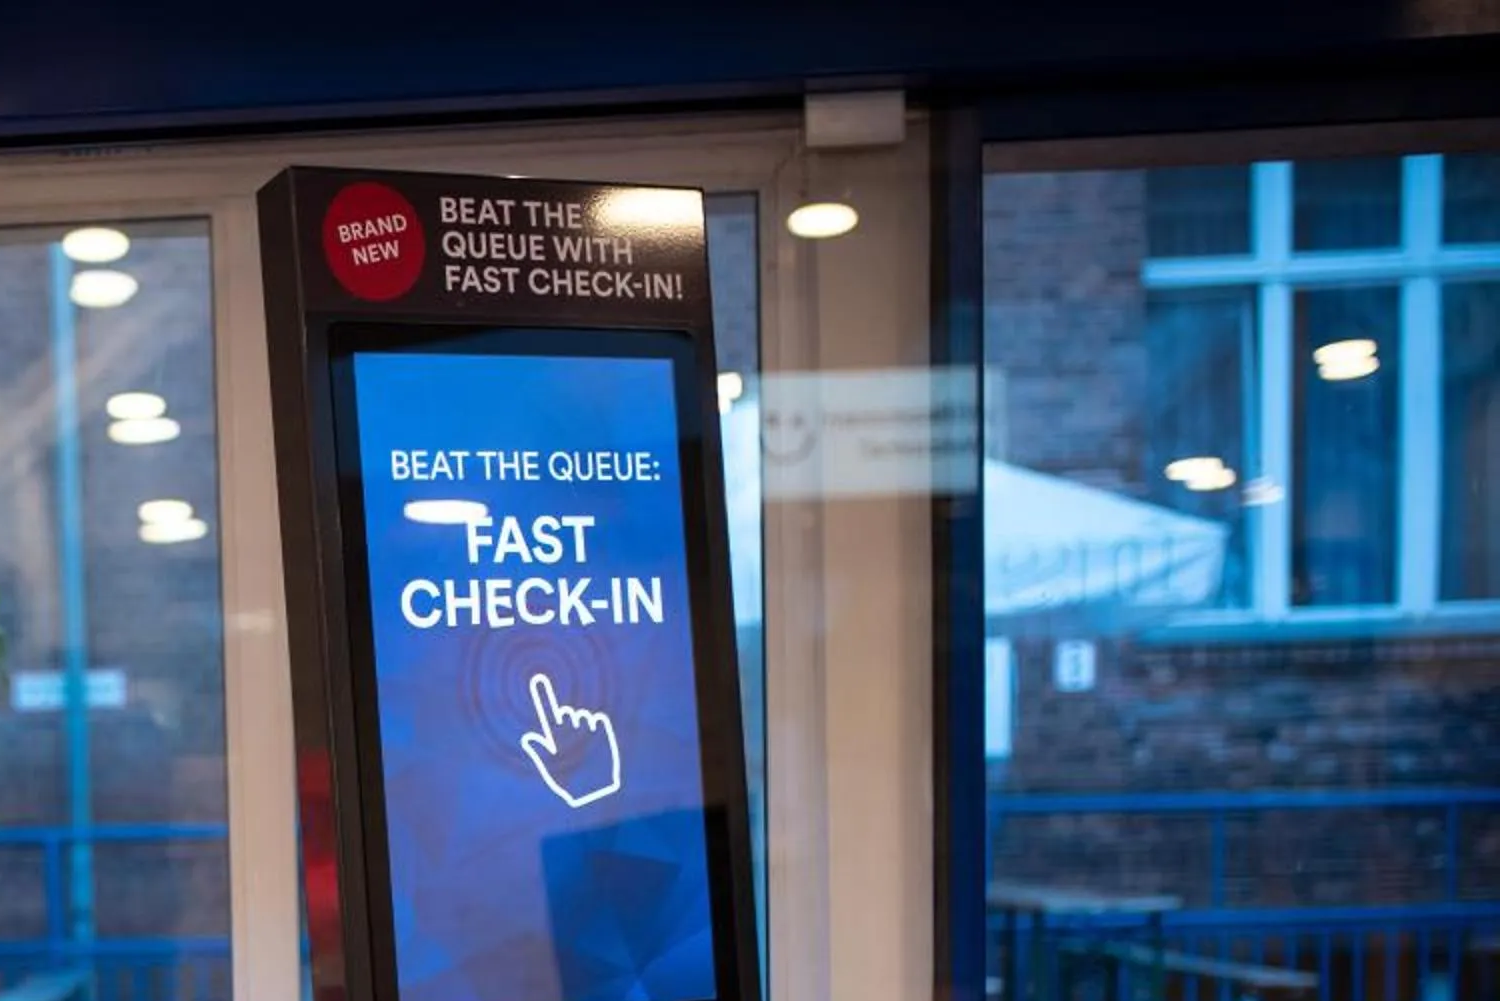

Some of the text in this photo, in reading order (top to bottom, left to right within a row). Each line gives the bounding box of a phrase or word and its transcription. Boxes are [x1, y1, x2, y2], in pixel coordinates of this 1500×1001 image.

[337, 213, 408, 243] BRAND
[439, 196, 582, 230] BEAT THE
[351, 239, 400, 267] NEW
[442, 230, 634, 266] QUEUE WITH
[444, 264, 684, 300] FAST CHECK-IN!
[391, 449, 662, 482] BEAT THE QUEUE:
[464, 514, 596, 564] FAST
[401, 576, 665, 629] CHECK-IN
